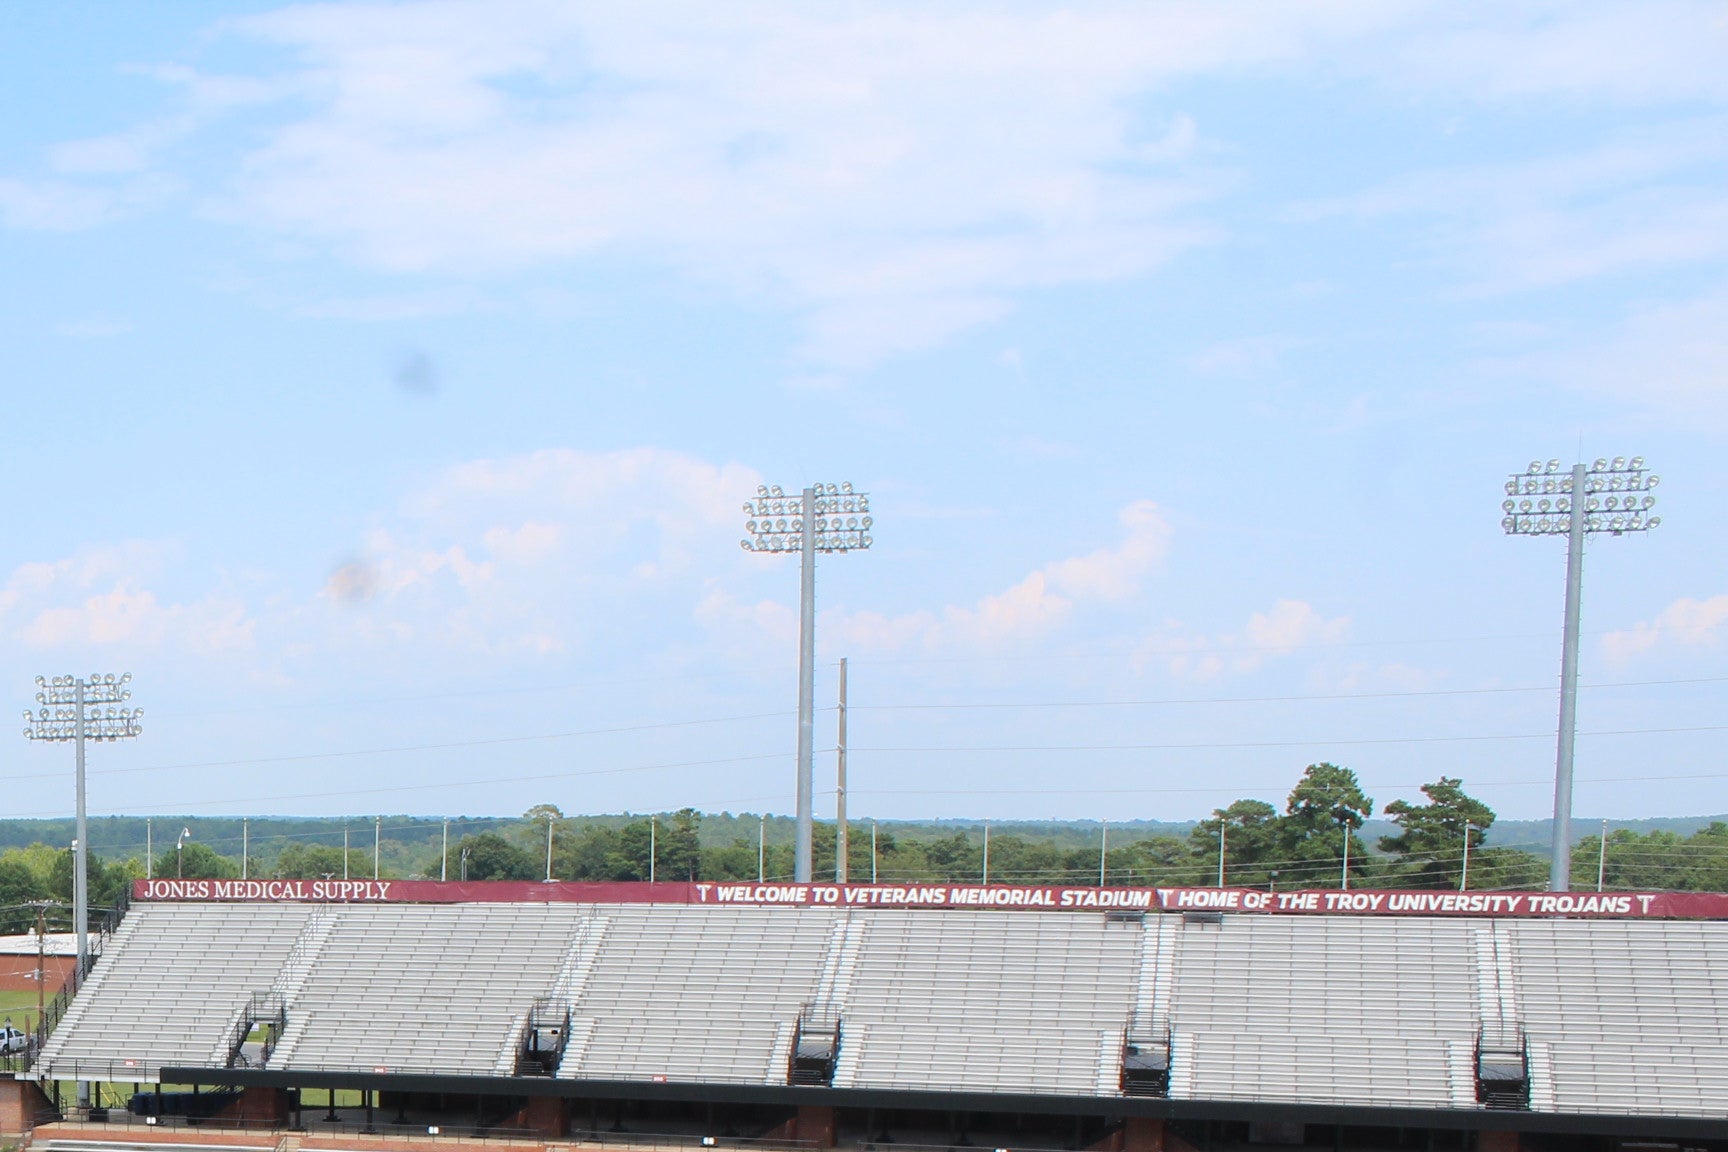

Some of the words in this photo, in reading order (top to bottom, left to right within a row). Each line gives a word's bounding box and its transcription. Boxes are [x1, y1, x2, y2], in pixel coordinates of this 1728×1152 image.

[144, 880, 209, 899] JONES
[213, 880, 309, 900] MEDICAL
[312, 881, 391, 900] SUPPLY
[717, 885, 807, 902] WELCOME
[812, 887, 839, 903] TO
[844, 887, 947, 904] VETERANS
[950, 888, 1056, 906] MEMORIAL
[1060, 889, 1152, 907] STADIUM
[1178, 890, 1239, 908] HOME
[1243, 893, 1273, 909] OF
[1277, 893, 1320, 910] THE
[1325, 893, 1385, 911] TROY
[1387, 894, 1522, 912] UNIVERSITY
[1528, 895, 1631, 914] TROJANS
